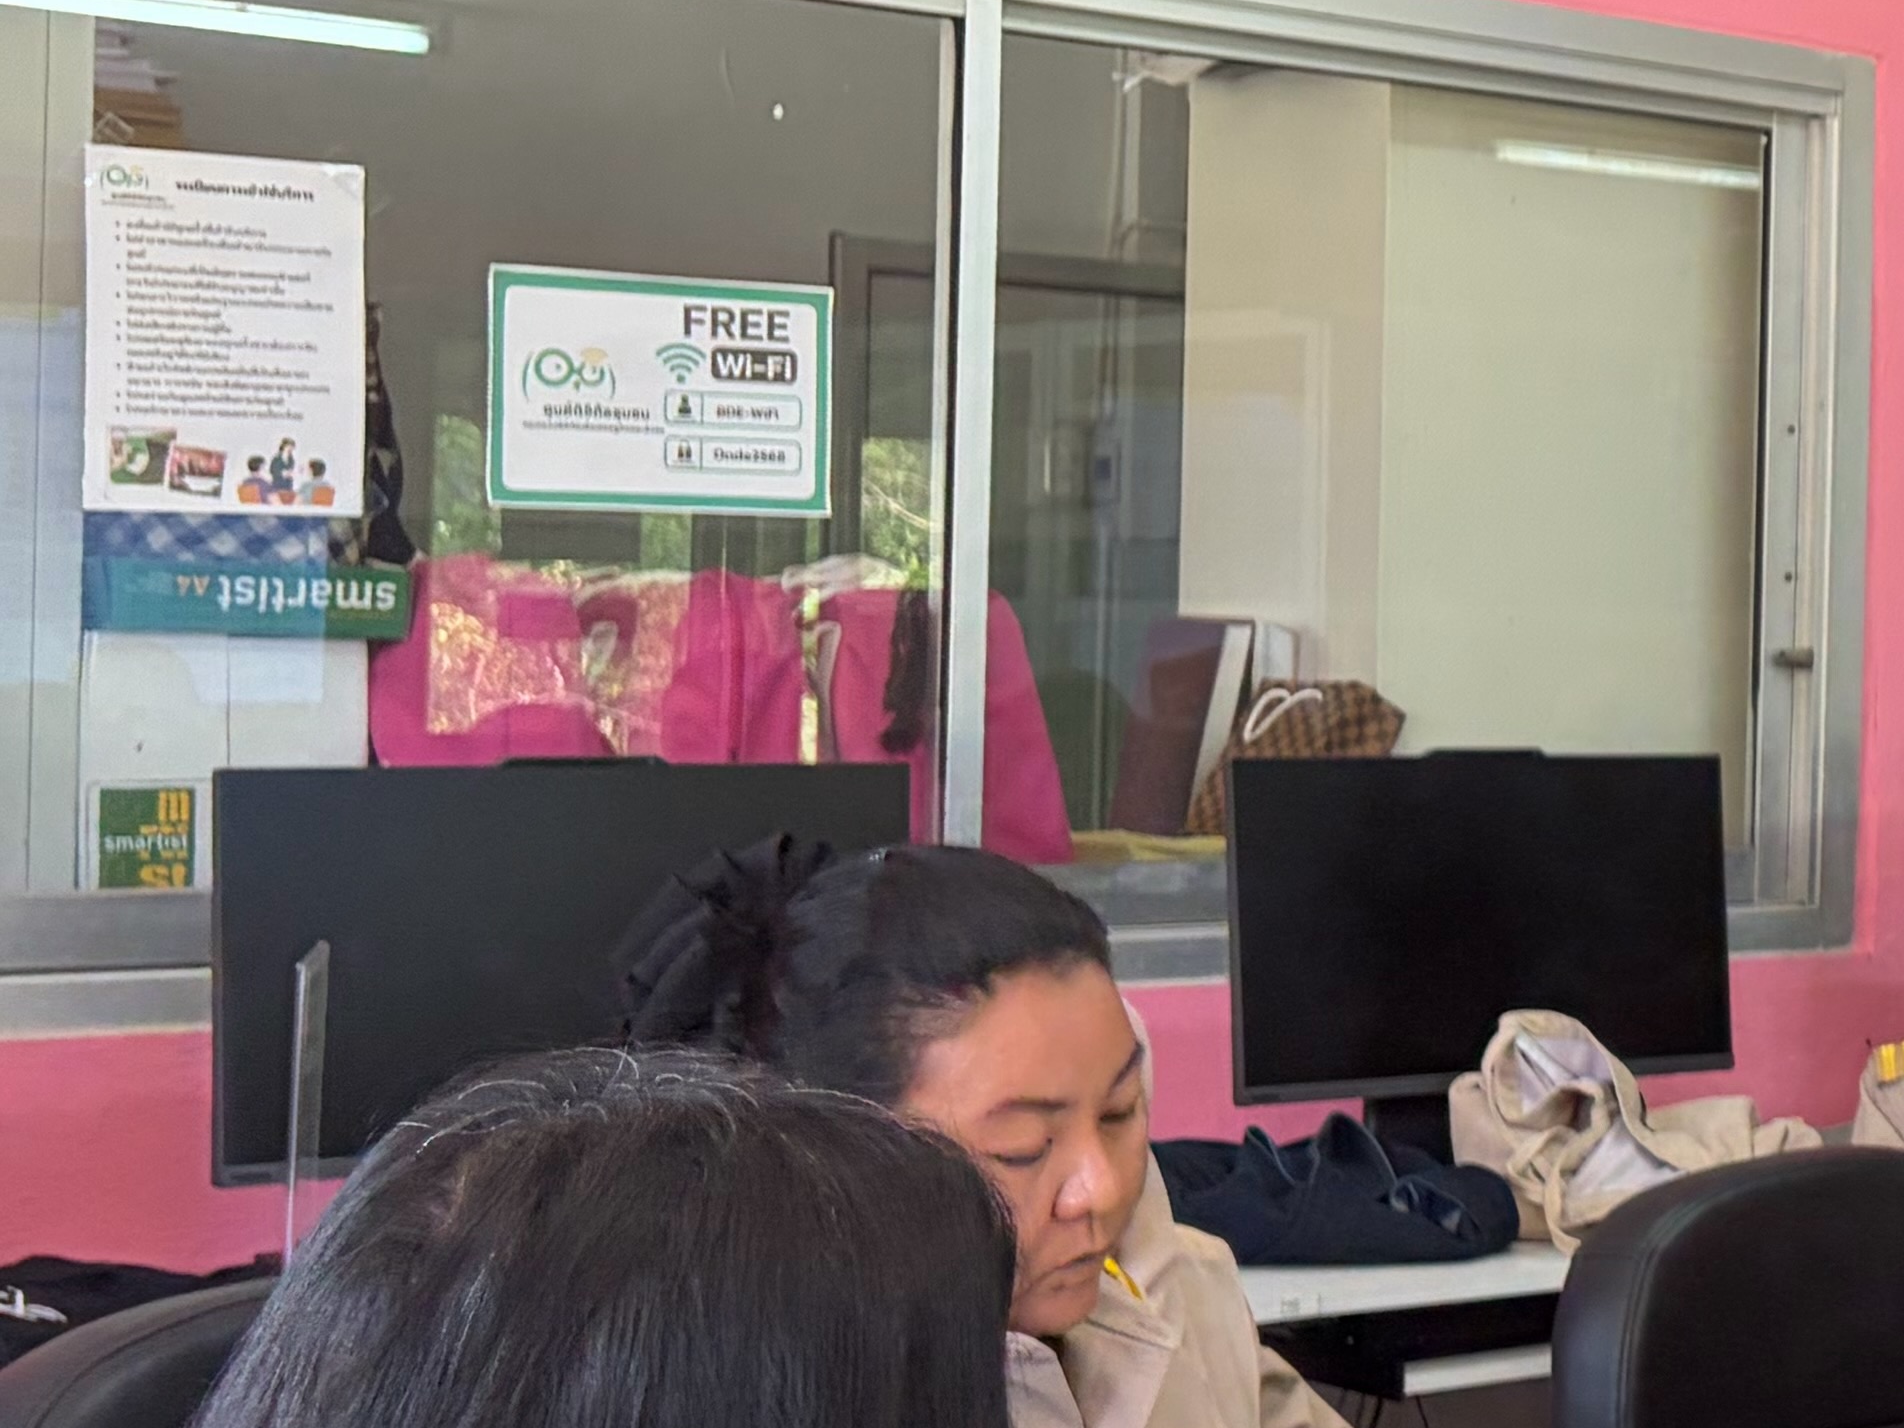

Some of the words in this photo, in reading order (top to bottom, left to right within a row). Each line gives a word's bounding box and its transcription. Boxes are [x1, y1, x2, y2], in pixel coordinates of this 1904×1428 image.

[683, 303, 791, 344] FREE
[716, 352, 792, 382] Wi-Fi
[216, 575, 398, 613] smartist
[104, 833, 187, 852] smartist
